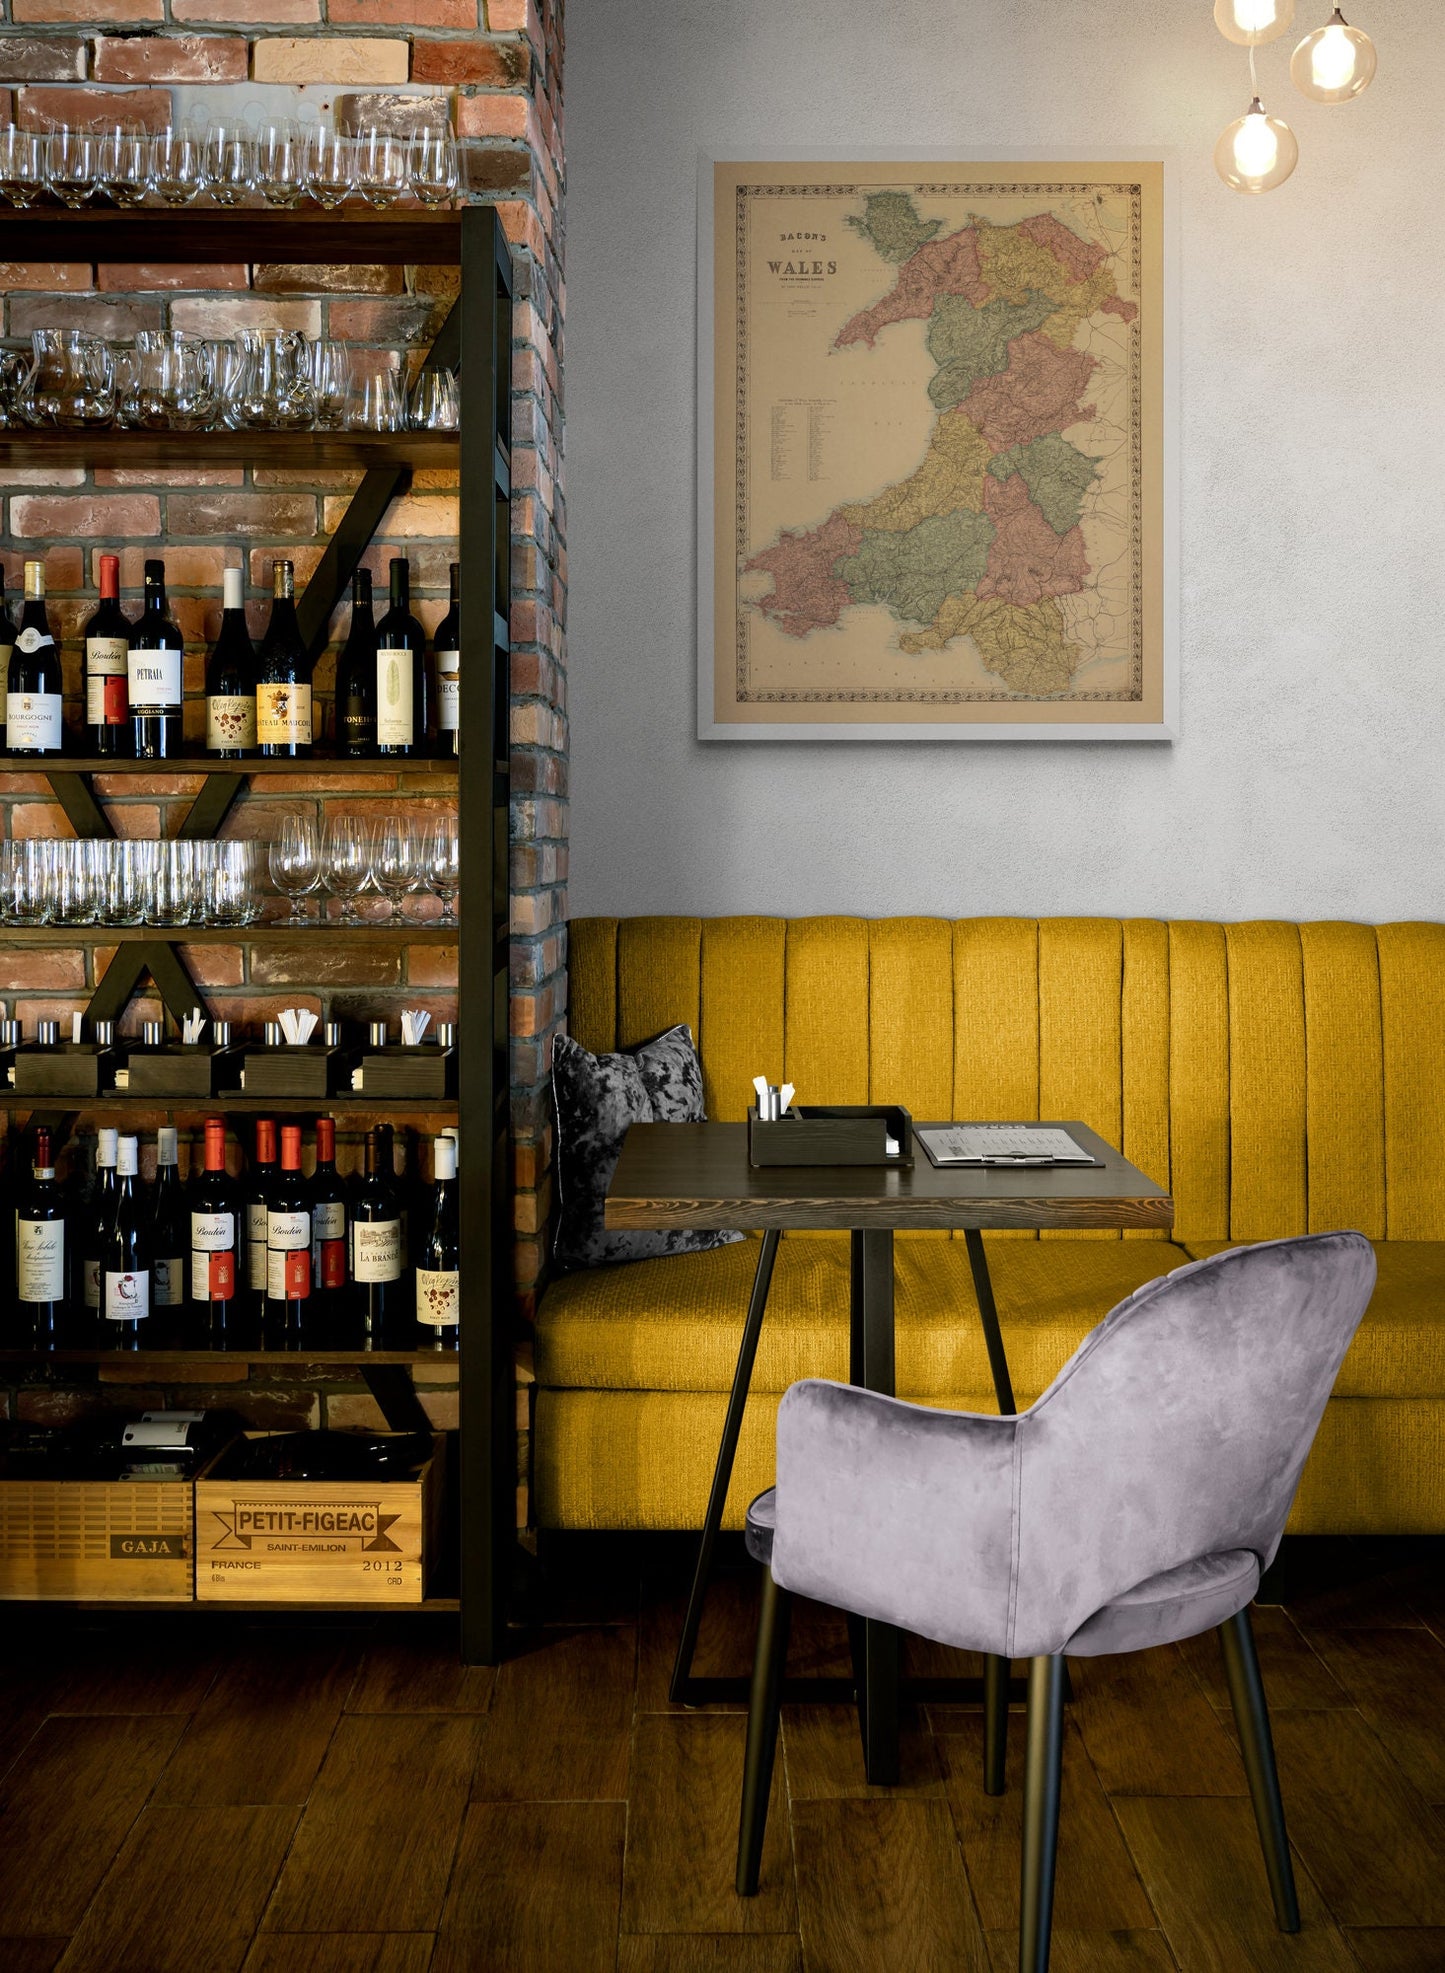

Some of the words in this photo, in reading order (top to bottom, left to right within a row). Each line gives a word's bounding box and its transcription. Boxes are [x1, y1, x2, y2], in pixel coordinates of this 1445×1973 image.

[779, 232, 827, 242] BACON'S
[767, 261, 837, 275] WALES
[91, 650, 121, 660] Bordón
[136, 668, 163, 681] PETRAIA
[8, 713, 53, 721] BOURGOGNE
[196, 1226, 226, 1236] Bordón
[272, 1225, 302, 1236] Bordón
[239, 1511, 375, 1531] PETIT-FIGEAC
[121, 1540, 172, 1553] GAJA
[267, 1543, 346, 1552] SAINT-EMILION
[211, 1560, 262, 1570] FRANCE
[362, 1561, 403, 1571] 2012
